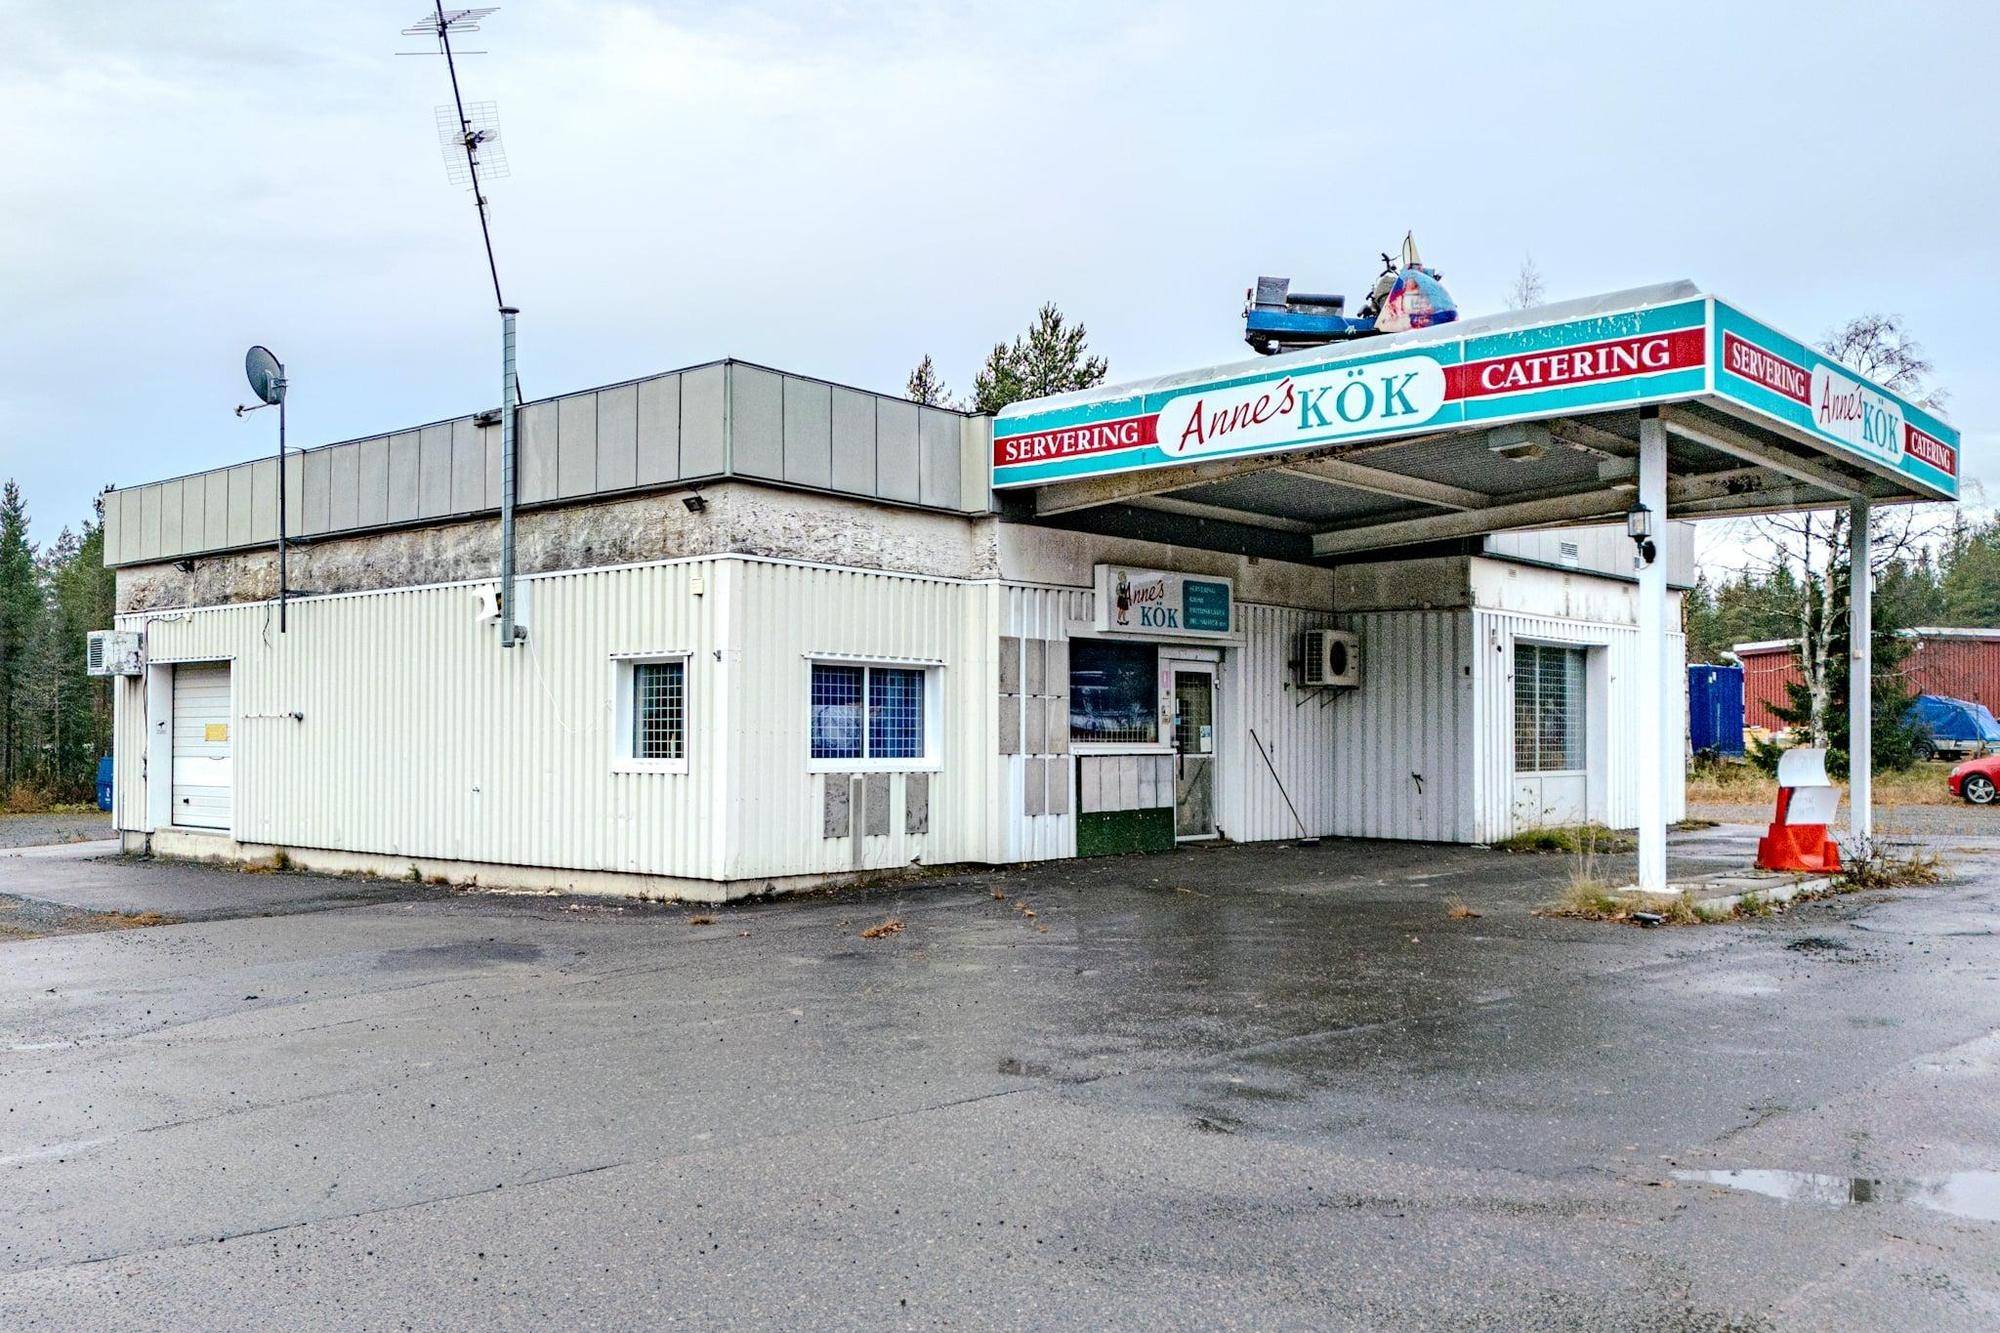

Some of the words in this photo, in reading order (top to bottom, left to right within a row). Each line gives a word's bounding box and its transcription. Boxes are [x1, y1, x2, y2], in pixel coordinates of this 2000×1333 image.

[1481, 339, 1670, 389] CATERING
[1732, 341, 1805, 399] SERVERING
[1297, 369, 1419, 429] KÖK
[1005, 422, 1139, 461] SERVERING
[1863, 398, 1899, 454] KÖK
[1911, 431, 1951, 470] CATERING
[1140, 602, 1179, 628] KÖK
